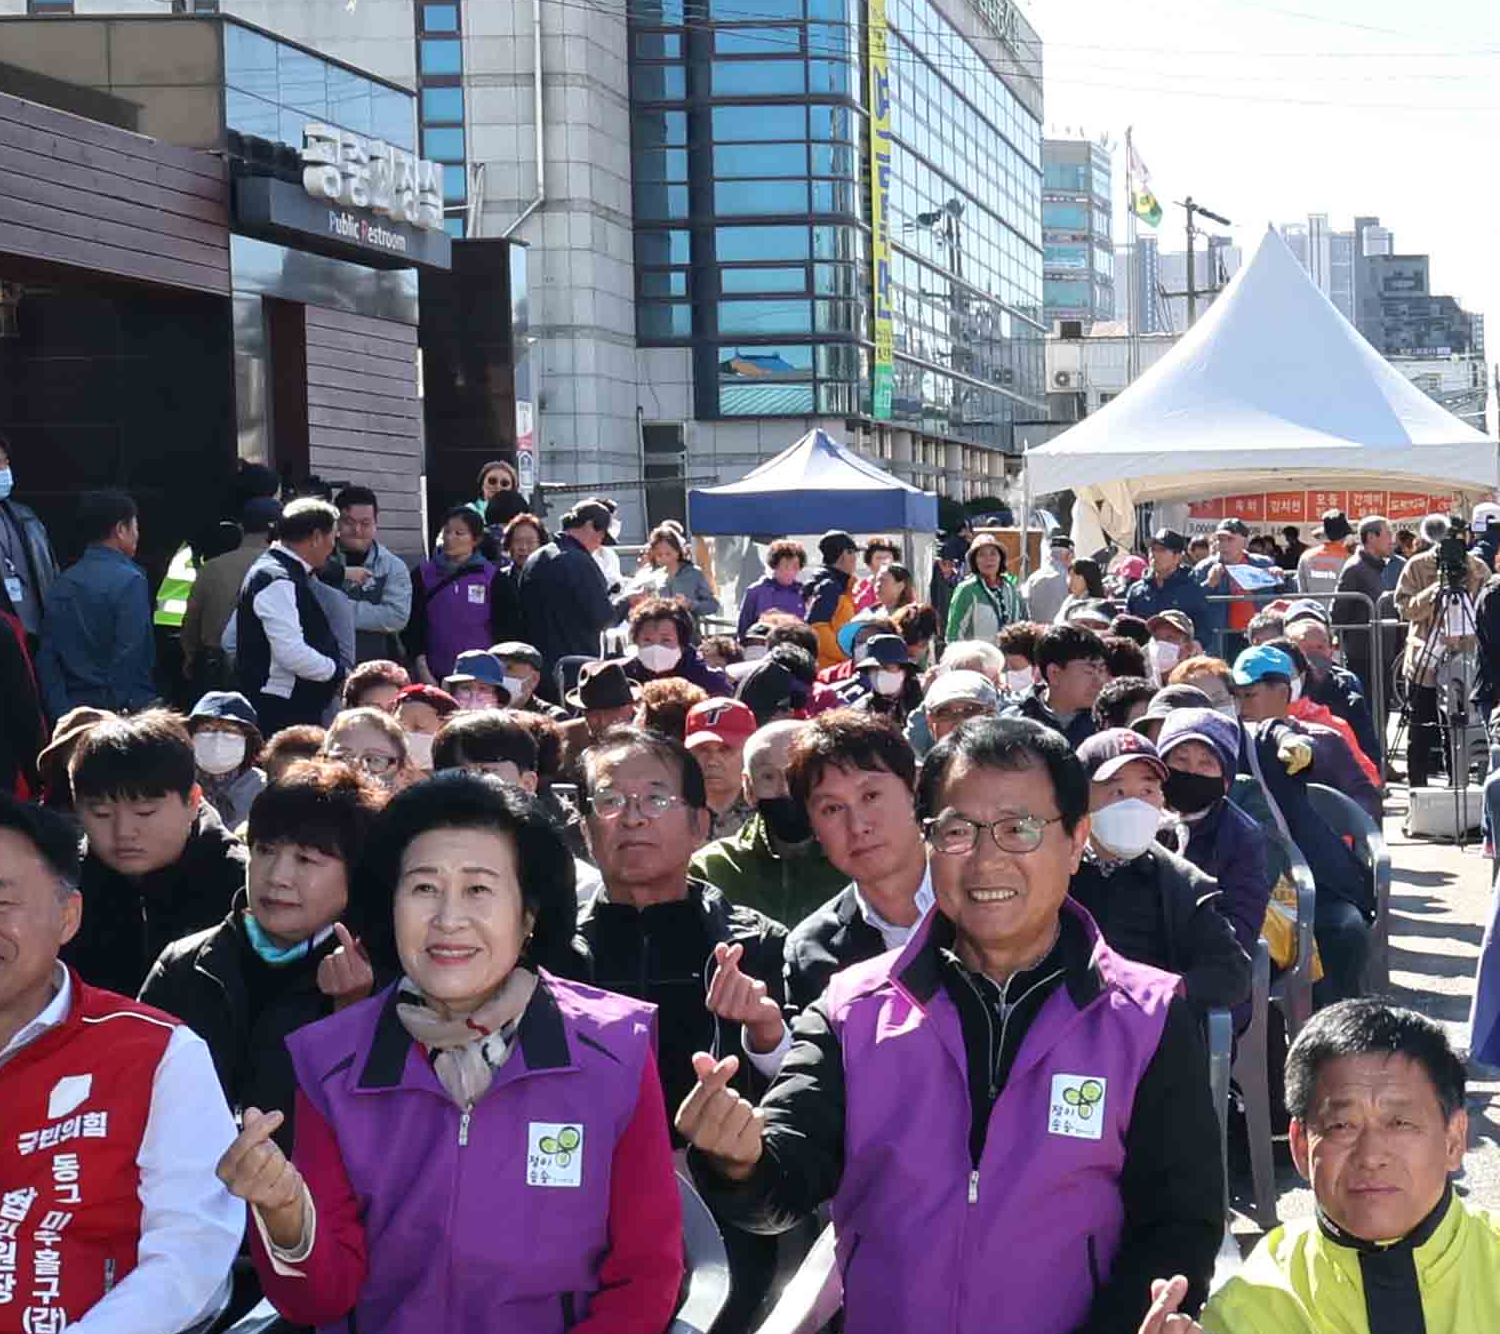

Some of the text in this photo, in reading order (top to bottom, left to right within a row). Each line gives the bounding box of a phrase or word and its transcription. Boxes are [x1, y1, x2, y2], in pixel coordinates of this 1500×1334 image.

[328, 210, 406, 252] Public Restroom
[17, 1111, 108, 1156] 국민의힘
